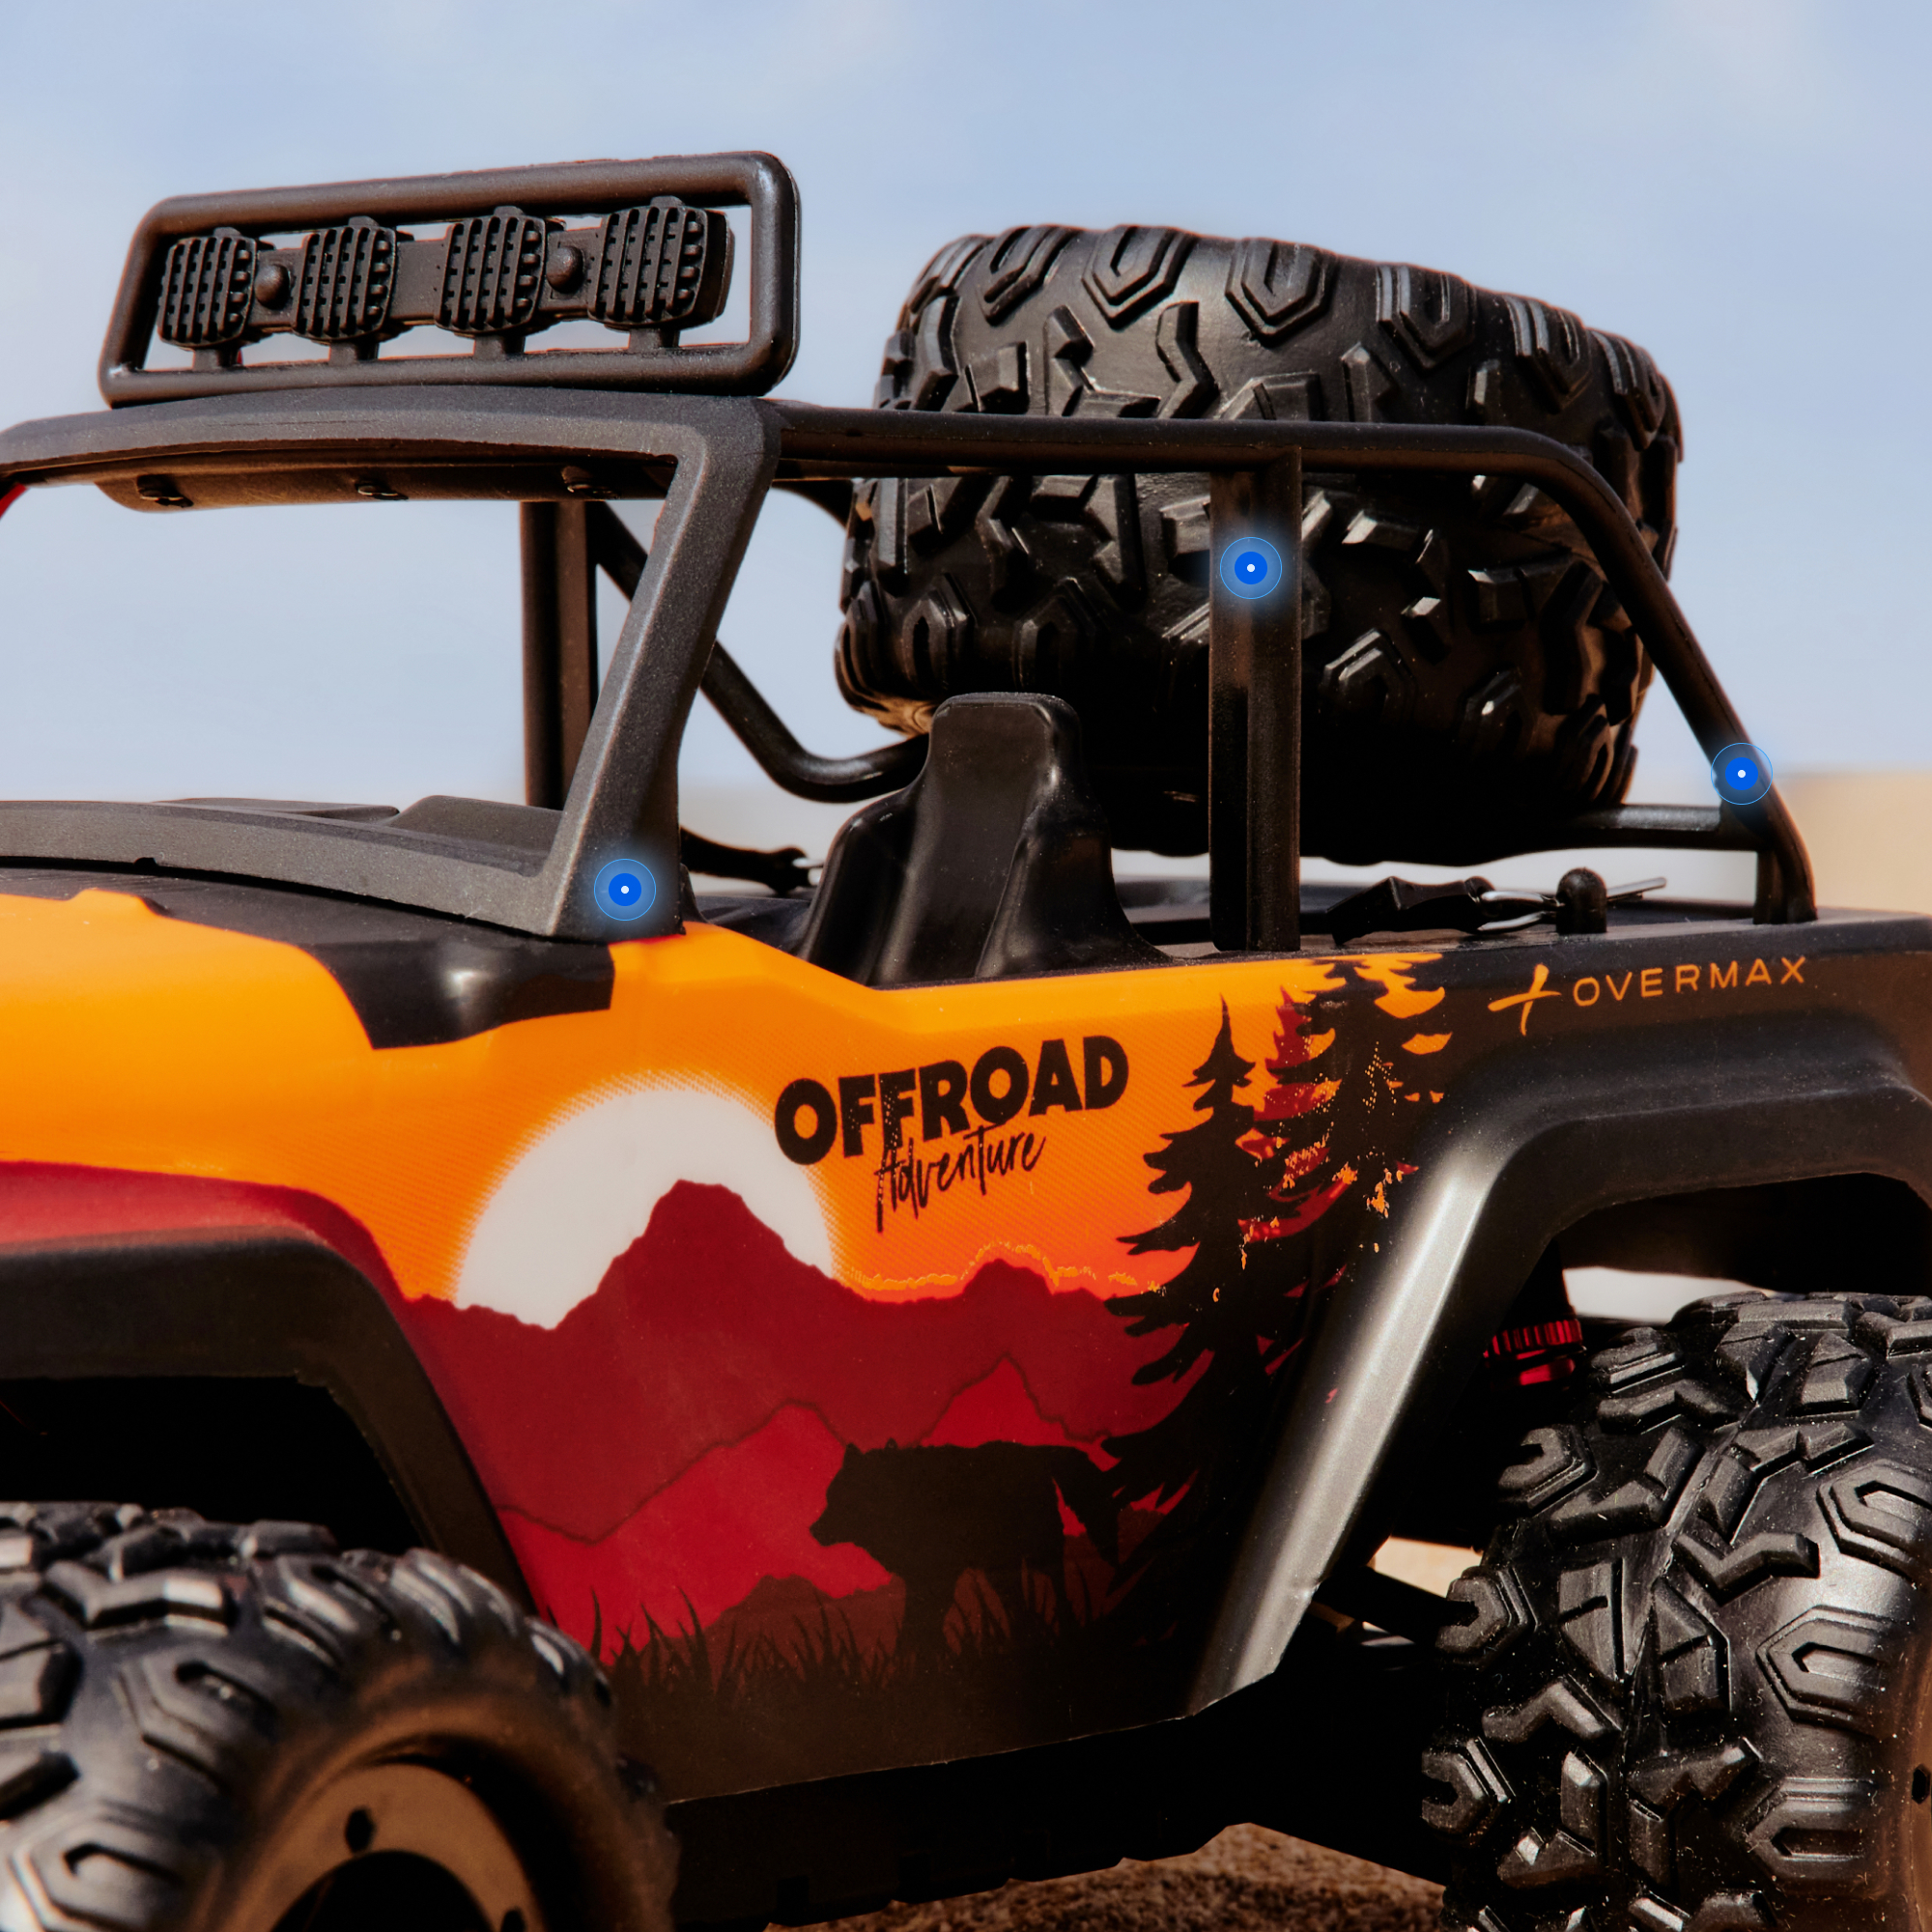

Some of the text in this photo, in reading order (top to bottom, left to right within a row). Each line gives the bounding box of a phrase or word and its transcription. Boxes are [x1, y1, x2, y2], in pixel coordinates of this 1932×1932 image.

[1573, 955, 1805, 1007] OVERMAX
[775, 1036, 1129, 1165] OFFROAD
[874, 1124, 1046, 1234] Adventure
